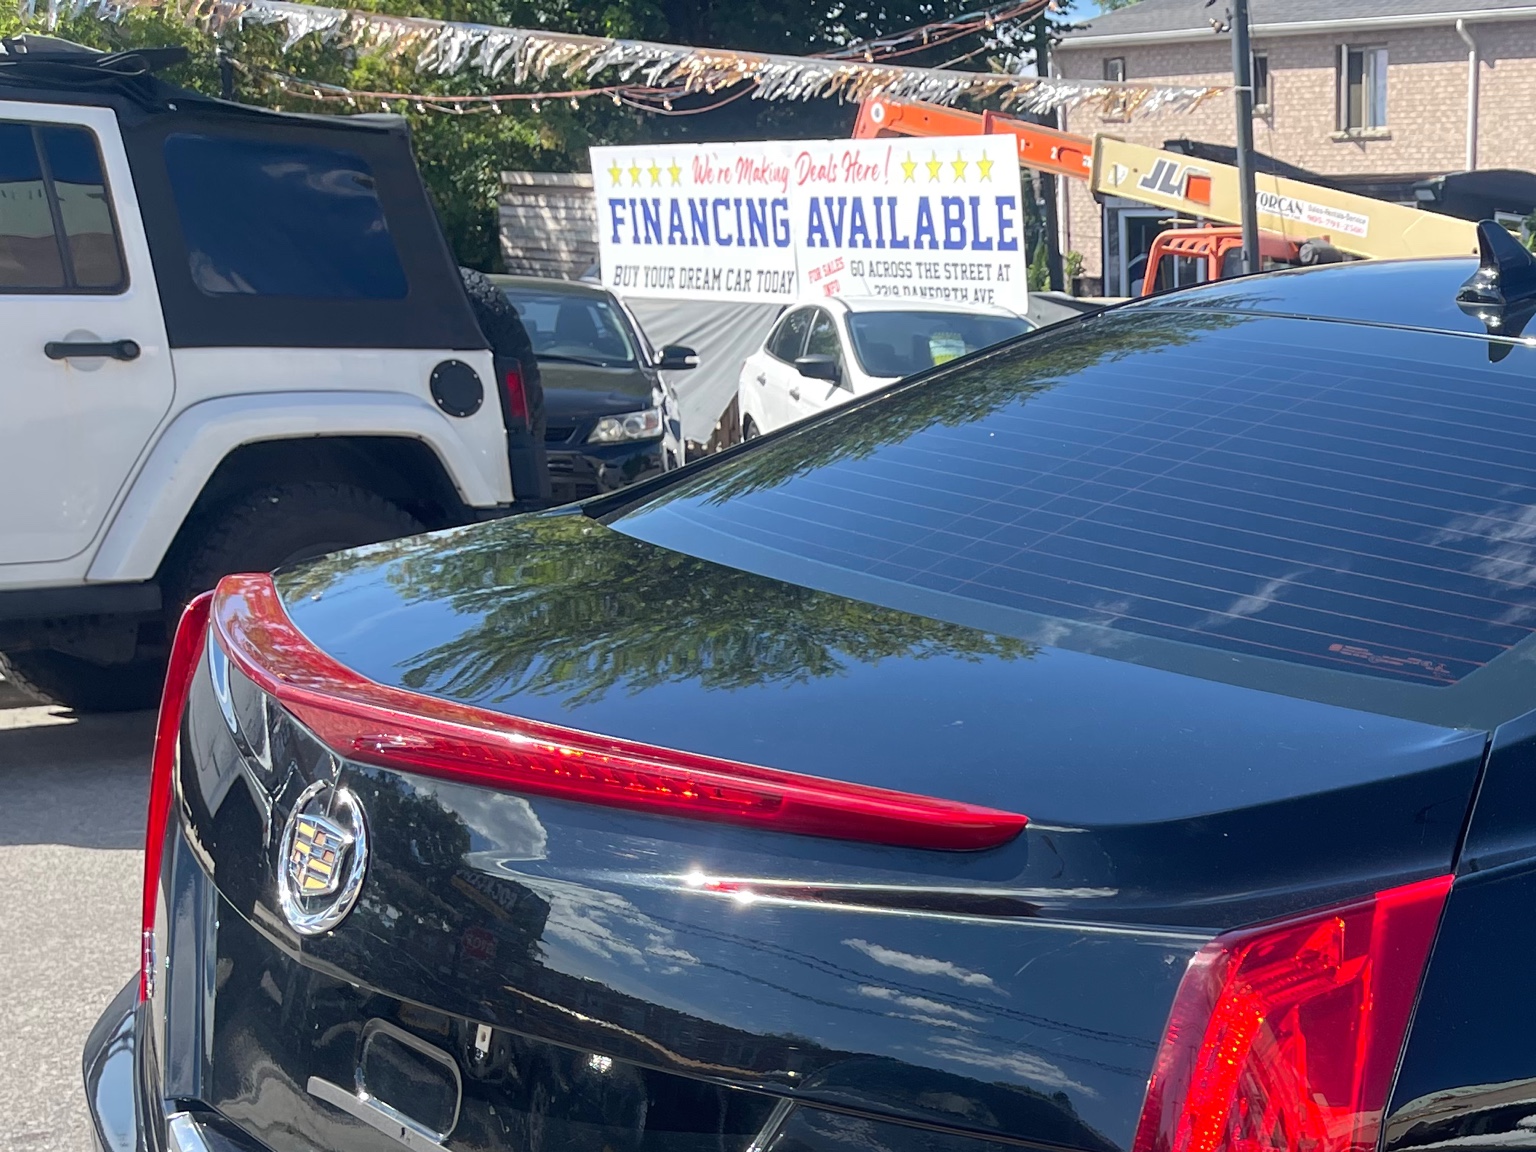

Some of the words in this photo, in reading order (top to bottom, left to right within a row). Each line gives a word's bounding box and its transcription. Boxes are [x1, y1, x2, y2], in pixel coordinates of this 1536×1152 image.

[692, 152, 732, 186] We're
[735, 154, 790, 194] Making
[795, 150, 838, 187] Deals
[608, 197, 791, 248] FINANCING
[806, 195, 1019, 252] AVAILABLE
[613, 264, 640, 288] BUY
[643, 265, 675, 290] YOUR
[678, 267, 722, 292] DREAM
[725, 268, 752, 293] CAR
[756, 269, 795, 295] TODAY
[807, 266, 822, 284] FOR
[822, 256, 845, 276] SALES
[850, 260, 865, 278] GO
[868, 260, 913, 280] ACROSS
[915, 262, 940, 280] THE
[943, 262, 992, 282] STREET
[996, 263, 1011, 282] AT
[973, 288, 995, 305] AVE
